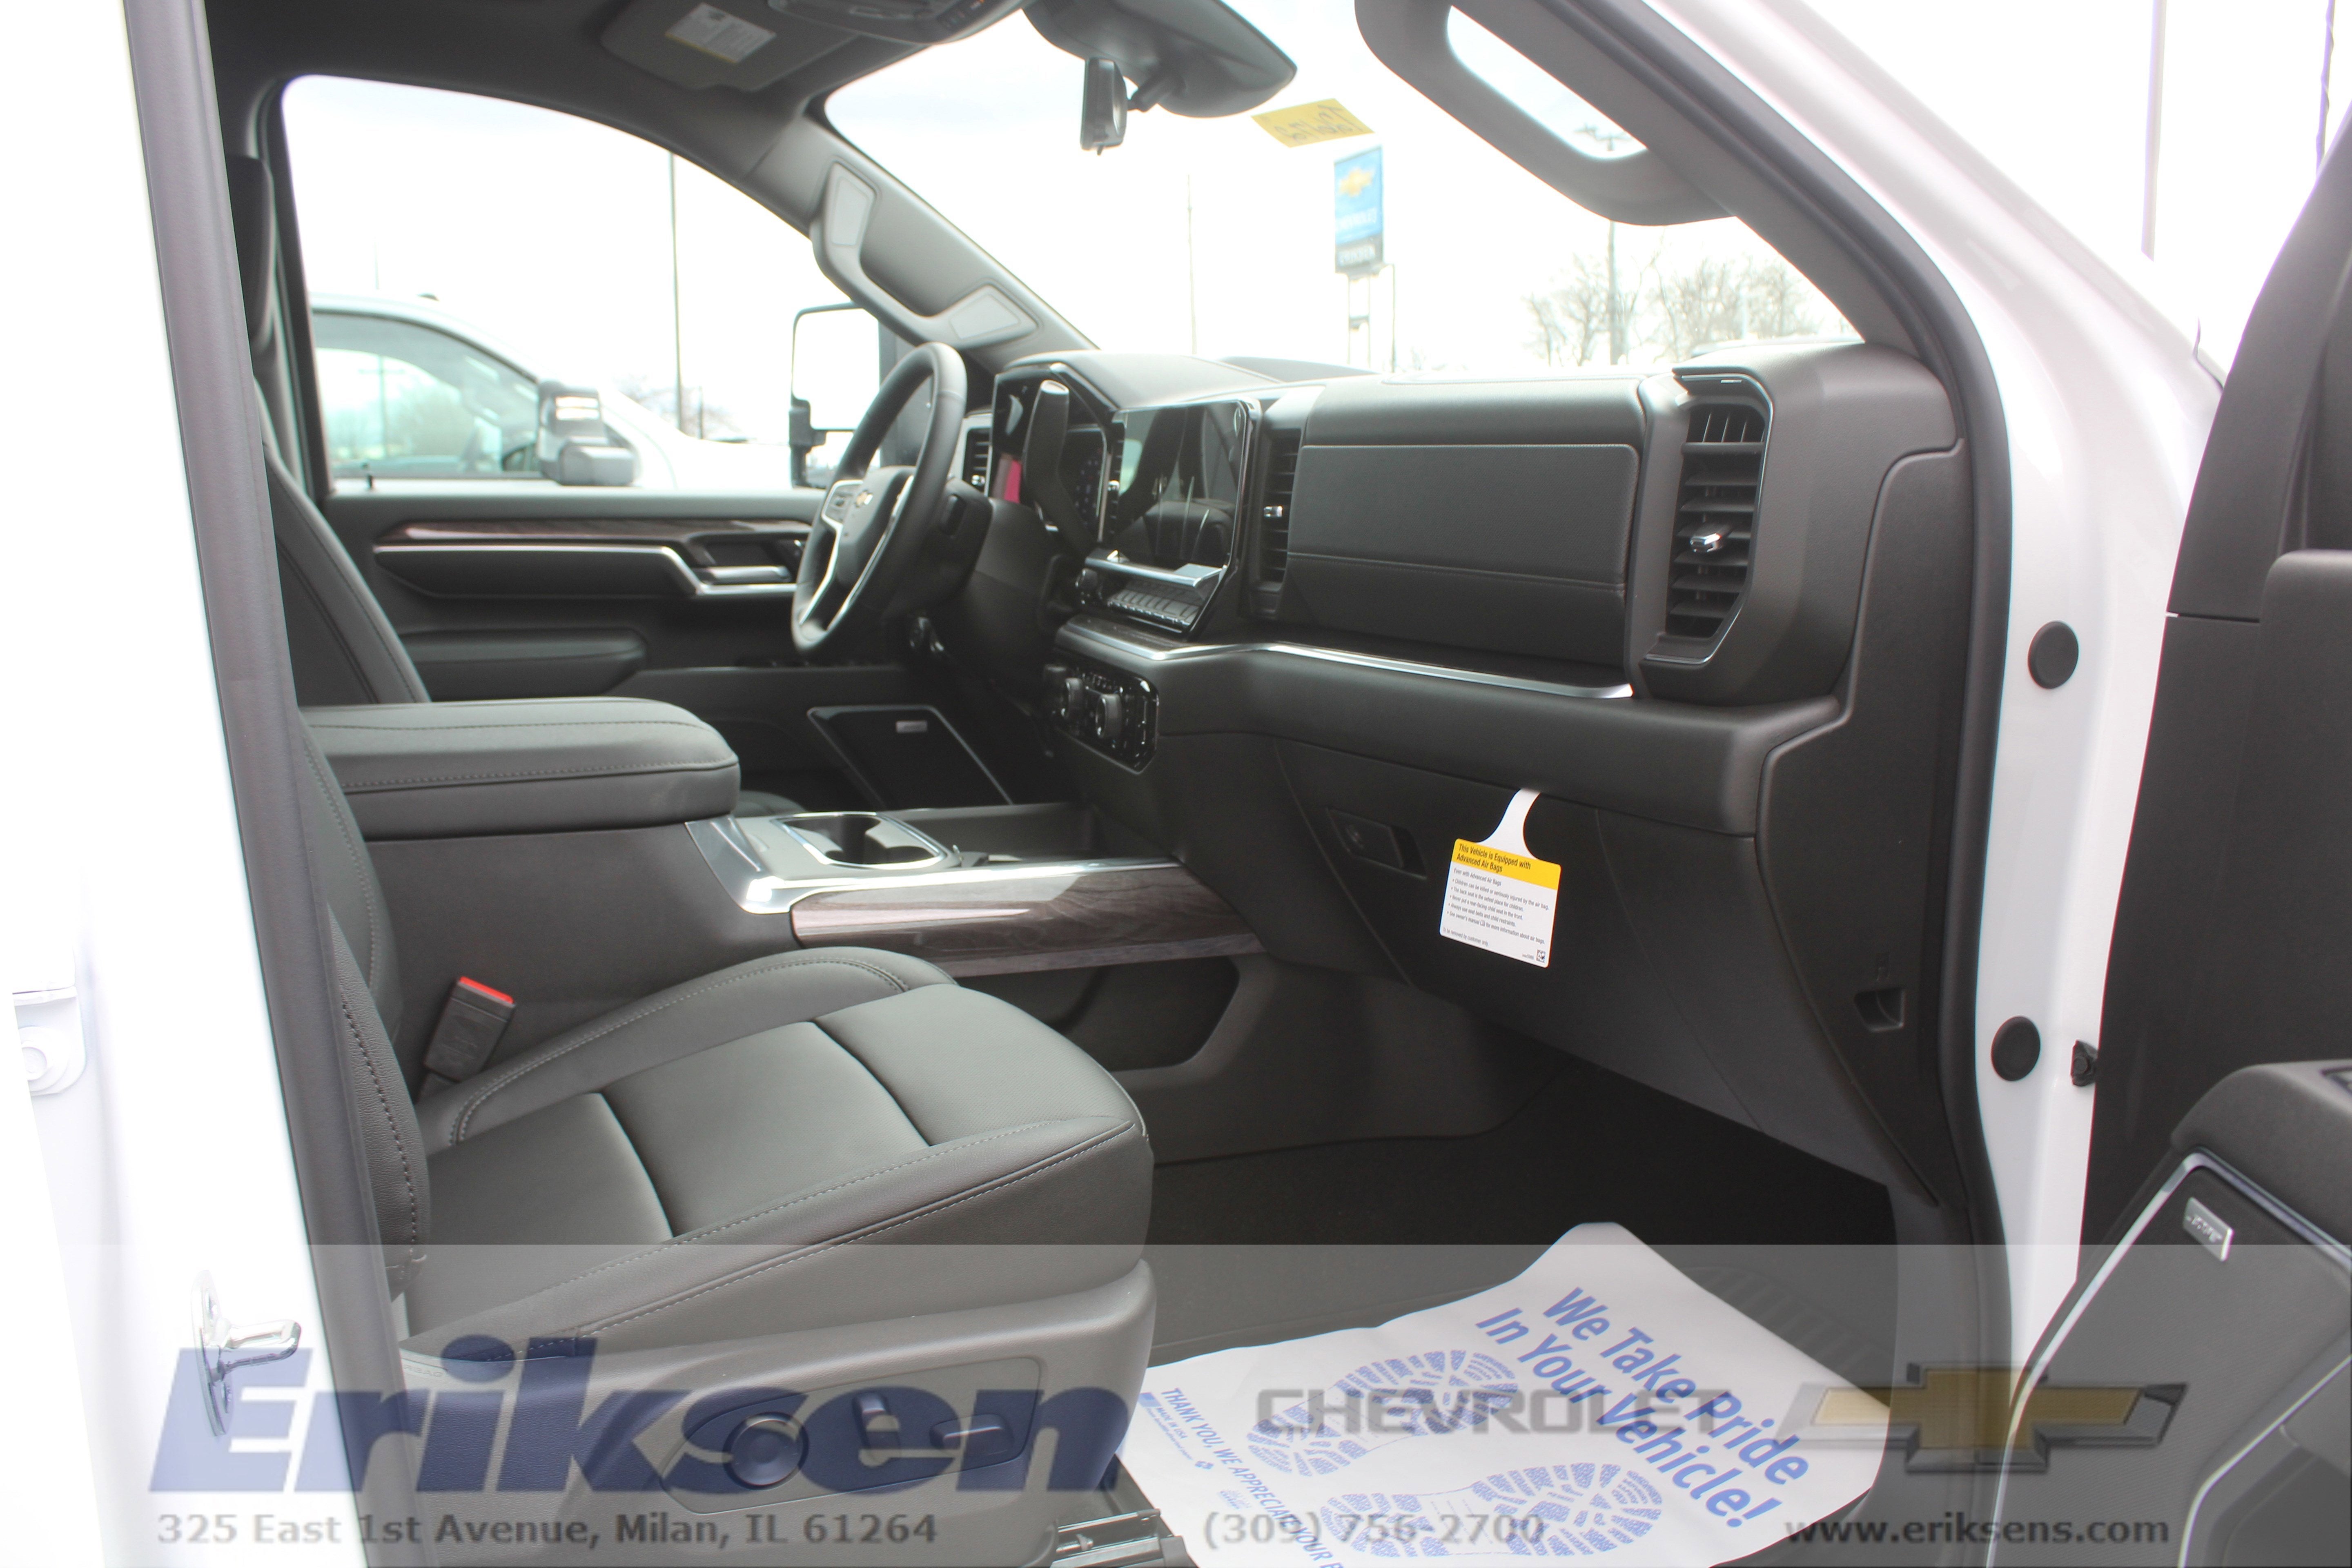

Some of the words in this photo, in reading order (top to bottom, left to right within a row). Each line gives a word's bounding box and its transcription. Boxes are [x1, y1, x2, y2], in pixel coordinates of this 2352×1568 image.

[1457, 853, 1480, 865] Advanced
[1490, 862, 1502, 873] Bags
[1459, 844, 1468, 852] This
[1470, 847, 1487, 858] Vehicle
[1494, 853, 1517, 867] Equipped
[1519, 860, 1530, 869] with
[1470, 872, 1486, 881] Advanced
[1492, 879, 1501, 887] Bags
[1494, 890, 1509, 899] seriously
[1510, 894, 1522, 903] injured
[1500, 927, 1519, 936] information
[403, 1365, 443, 1378] RBAG
[1543, 1287, 1610, 1341] We
[1599, 1327, 1696, 1403] Take
[1684, 1391, 1809, 1485] Pride
[1161, 1388, 1205, 1423] THANK
[1475, 1307, 1529, 1344] In
[1517, 1334, 1612, 1403] Your
[1596, 1393, 1782, 1527] Vehicle!
[1156, 1407, 1174, 1421] MADE
[1174, 1428, 1189, 1439] USA
[1191, 1423, 1224, 1448] YOU,
[1214, 1448, 1243, 1465] WE
[1228, 1468, 1302, 1528] APPRECIATE
[1289, 1527, 1334, 1561] YOUR
